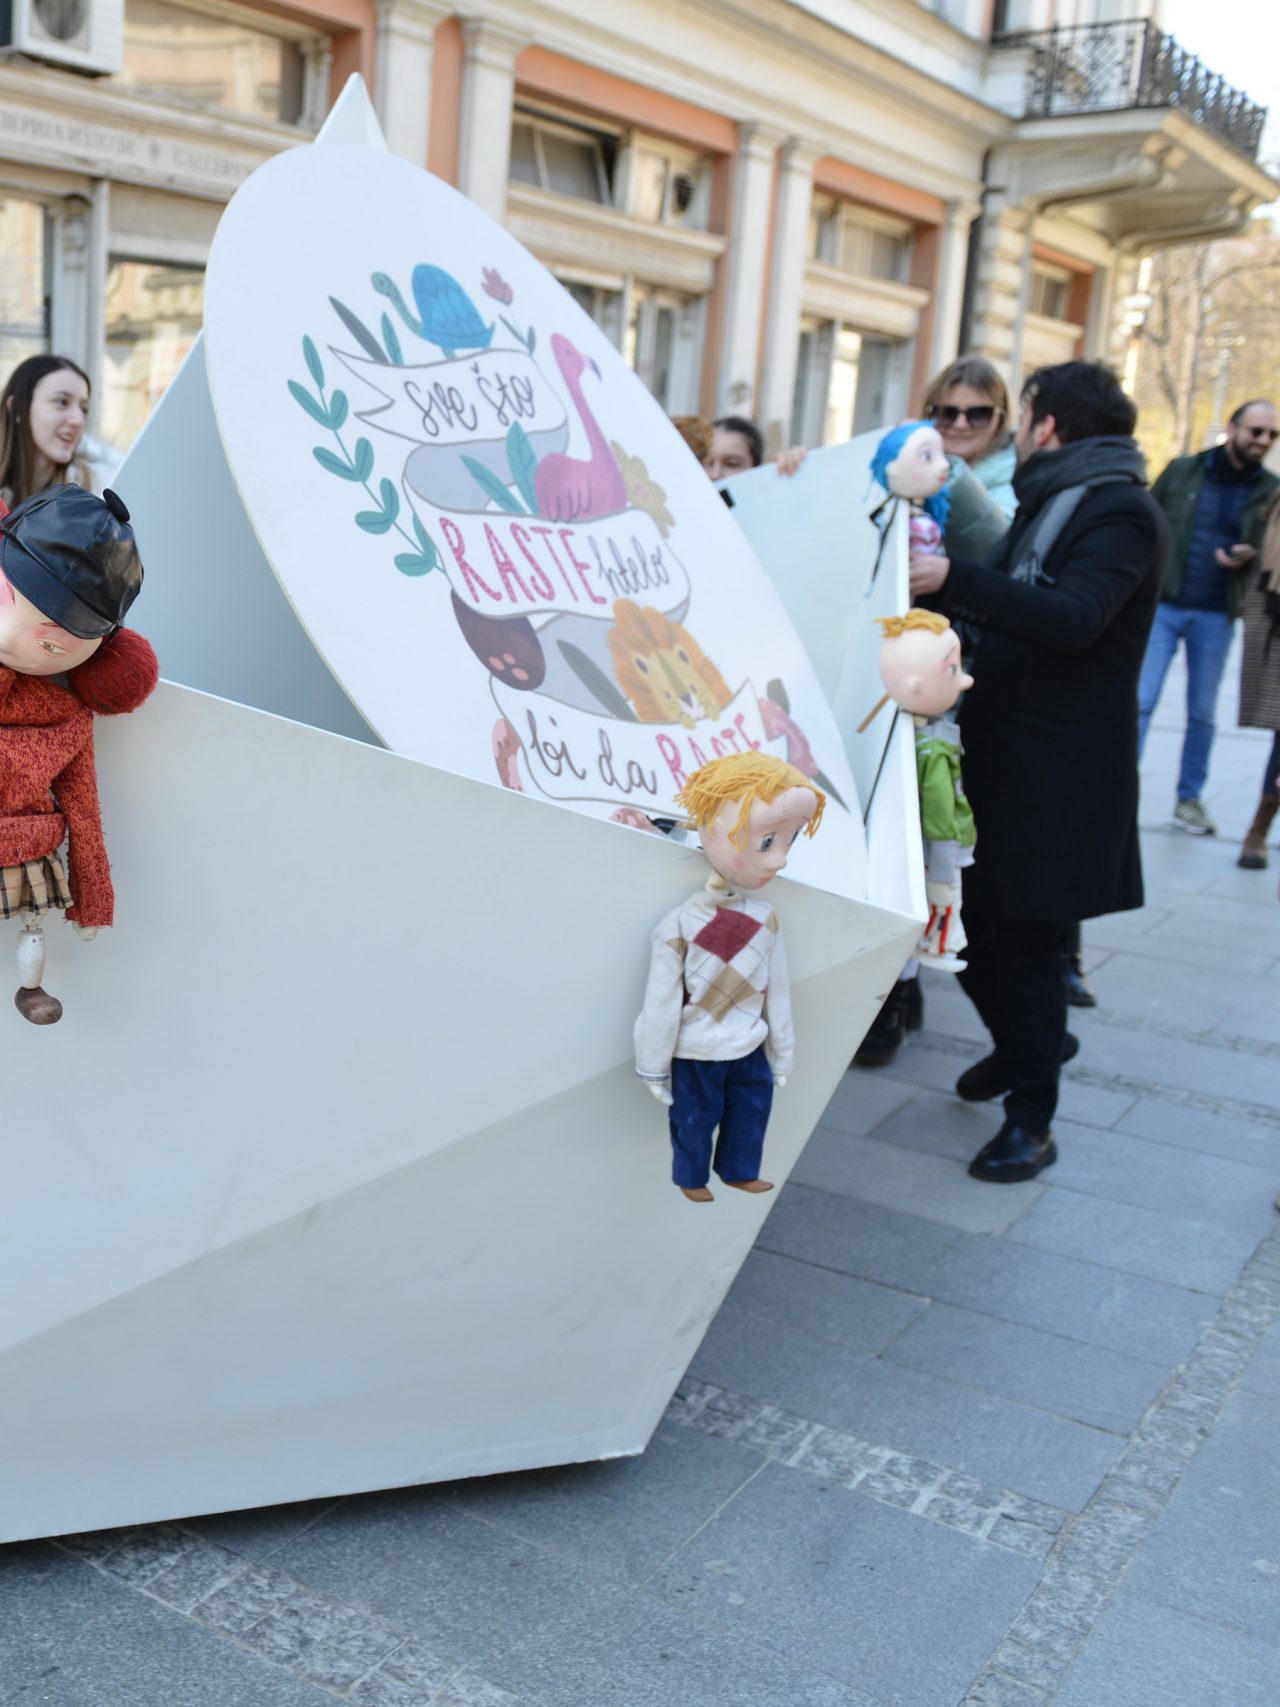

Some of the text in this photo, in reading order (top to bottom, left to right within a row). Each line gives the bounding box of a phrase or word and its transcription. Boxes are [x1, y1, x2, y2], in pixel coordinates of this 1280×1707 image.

[470, 361, 536, 427] što
[438, 516, 671, 605] RASTE htelo
[526, 708, 587, 781] bi
[597, 728, 658, 796] da
